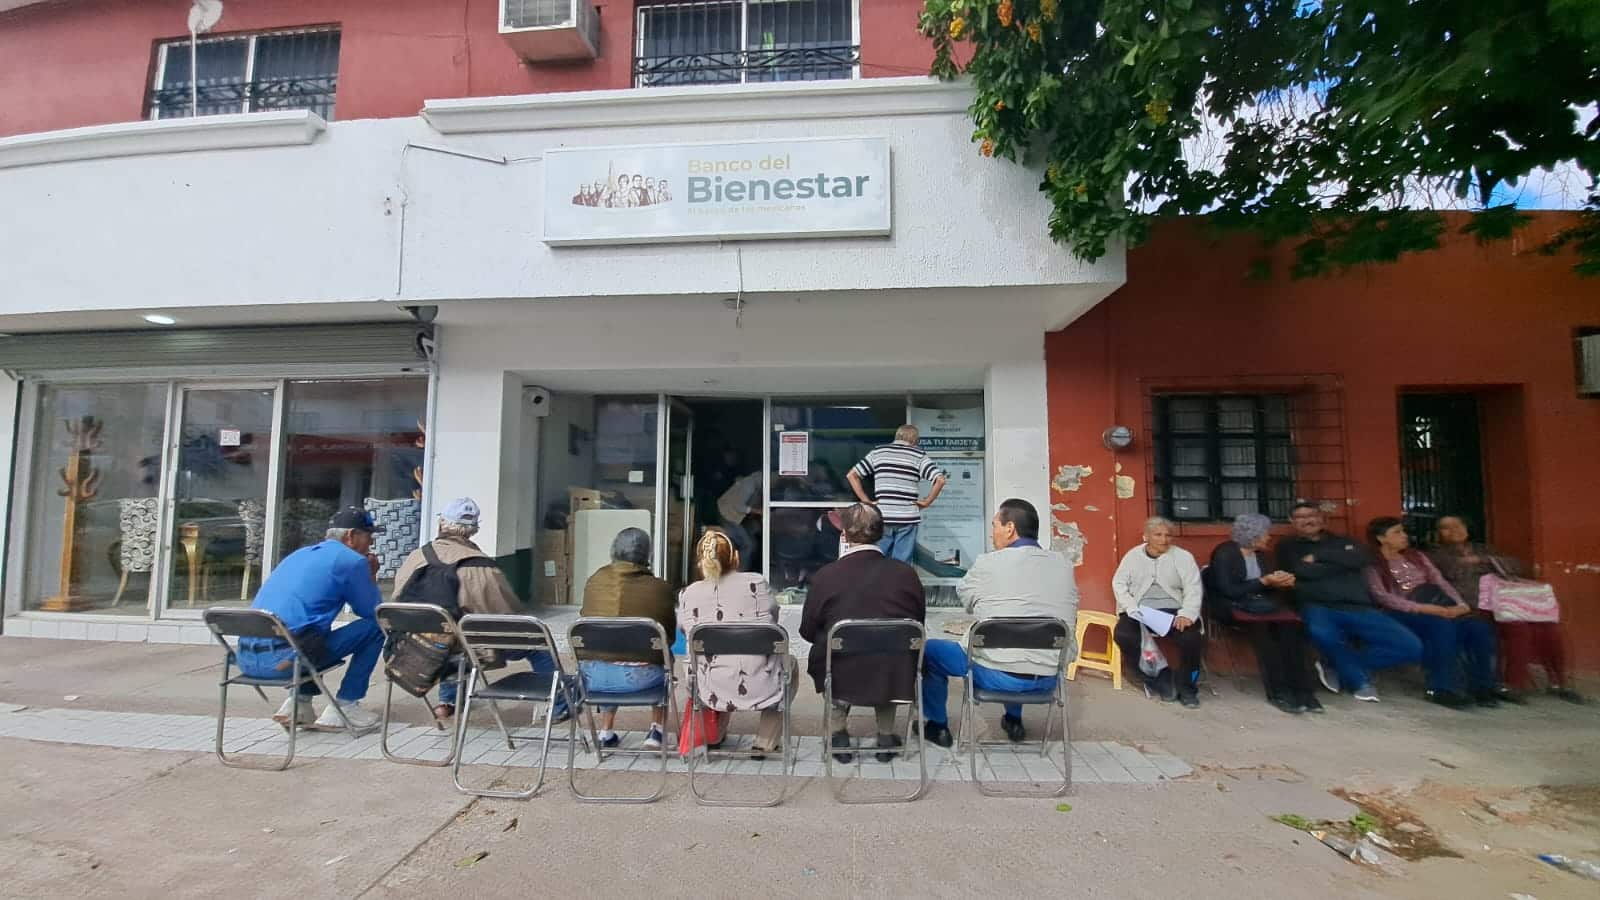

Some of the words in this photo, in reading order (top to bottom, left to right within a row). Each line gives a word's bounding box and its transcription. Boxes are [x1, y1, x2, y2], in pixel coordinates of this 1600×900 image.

[688, 159, 752, 173] Banco
[759, 153, 790, 170] del
[688, 173, 870, 203] Bienestar
